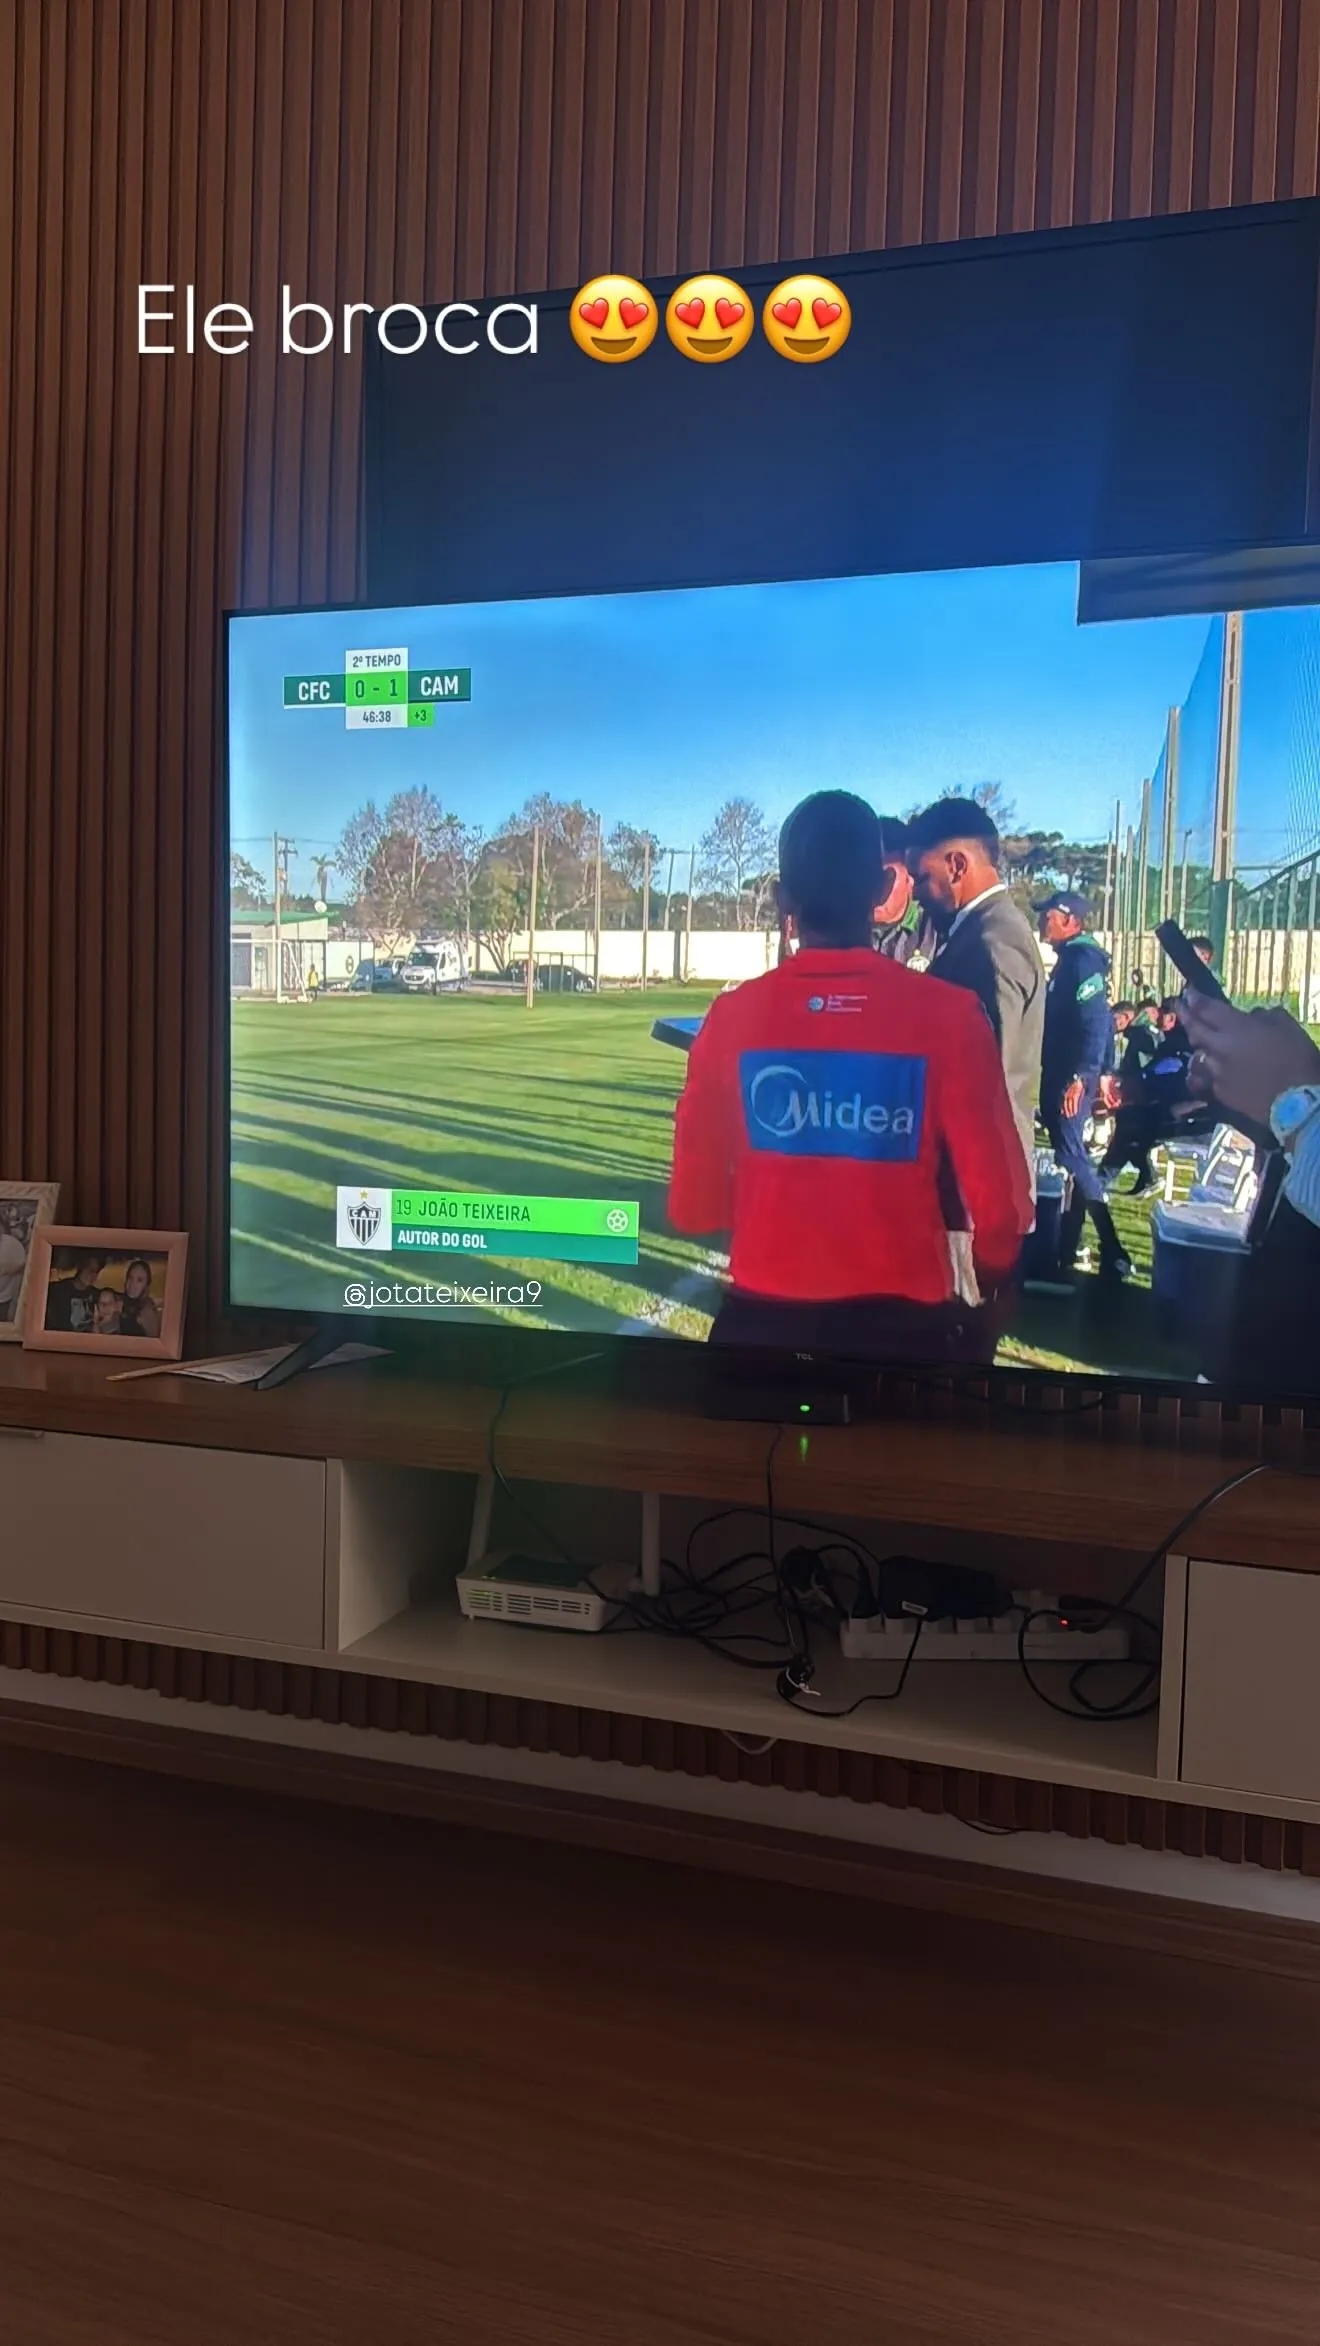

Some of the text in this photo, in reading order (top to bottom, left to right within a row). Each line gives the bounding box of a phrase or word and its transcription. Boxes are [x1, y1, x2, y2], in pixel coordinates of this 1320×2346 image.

[365, 654, 401, 667] TEMPO
[298, 681, 330, 701] CFC
[355, 680, 364, 698] 0
[389, 678, 398, 697] 1
[420, 675, 458, 696] CAM
[362, 711, 392, 723] 46:38
[414, 710, 427, 721] +3
[753, 1068, 914, 1136] Midea
[351, 1209, 377, 1218] CAM
[396, 1197, 531, 1222] 19 JOÃO TEIXEIRA
[397, 1229, 488, 1249] AUTOR DO GOL
[796, 1353, 813, 1361] TCL
